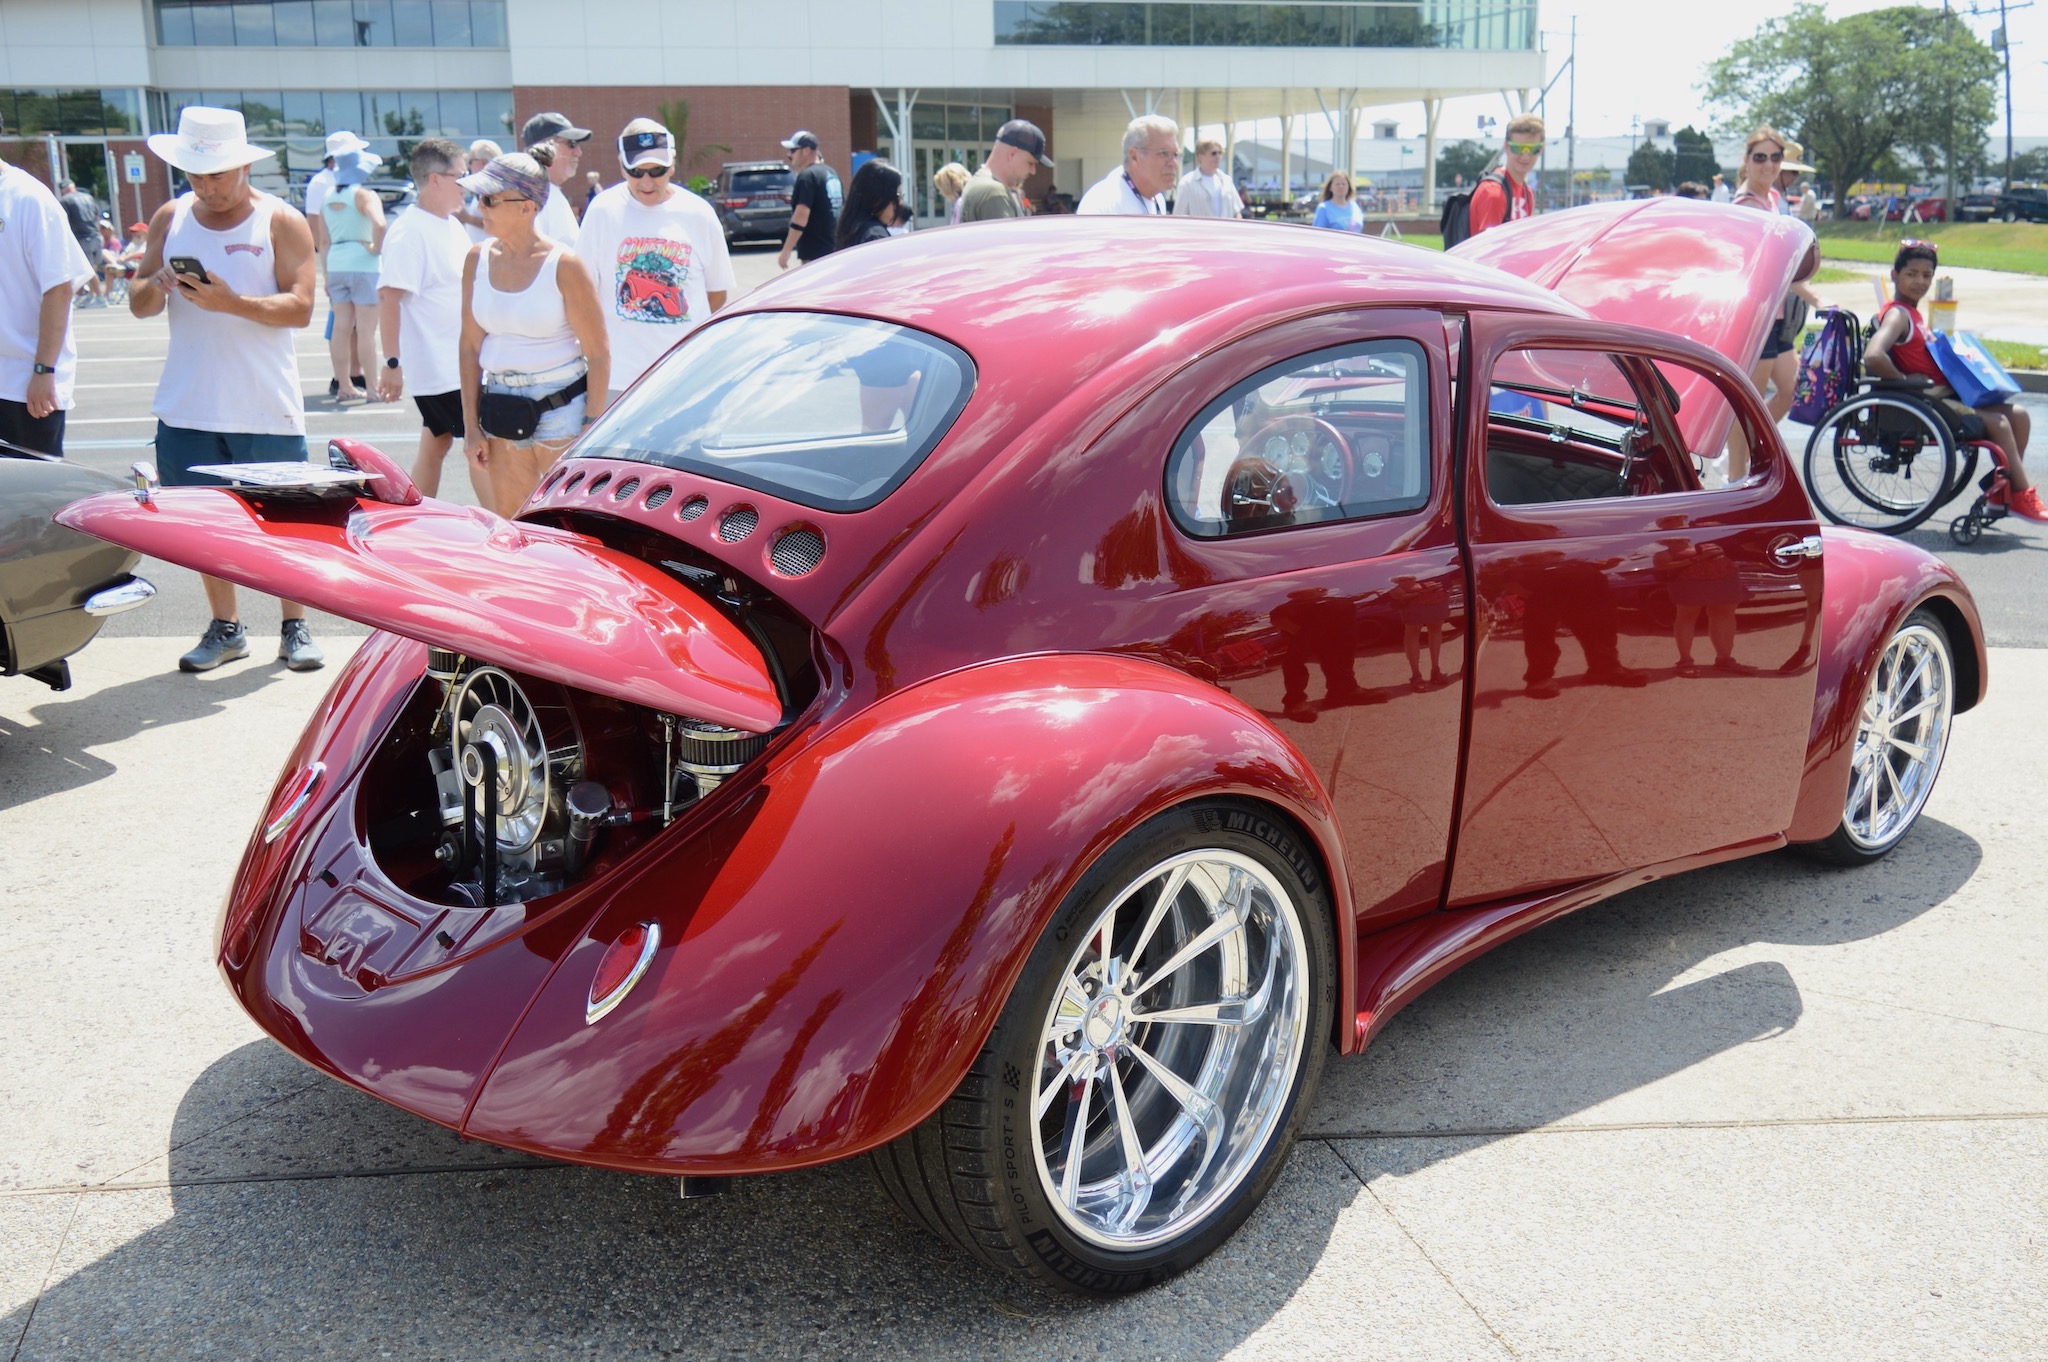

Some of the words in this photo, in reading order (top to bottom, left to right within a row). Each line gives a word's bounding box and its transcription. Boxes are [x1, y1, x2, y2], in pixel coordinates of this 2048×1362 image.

[617, 237, 692, 266] CONTENDER
[1227, 811, 1315, 886] MICHELIN
[1005, 1098, 1014, 1109] S
[1004, 1125, 1018, 1179] SPORT
[1011, 1186, 1033, 1224] PILOT
[1033, 1236, 1146, 1291] MICHELIN
